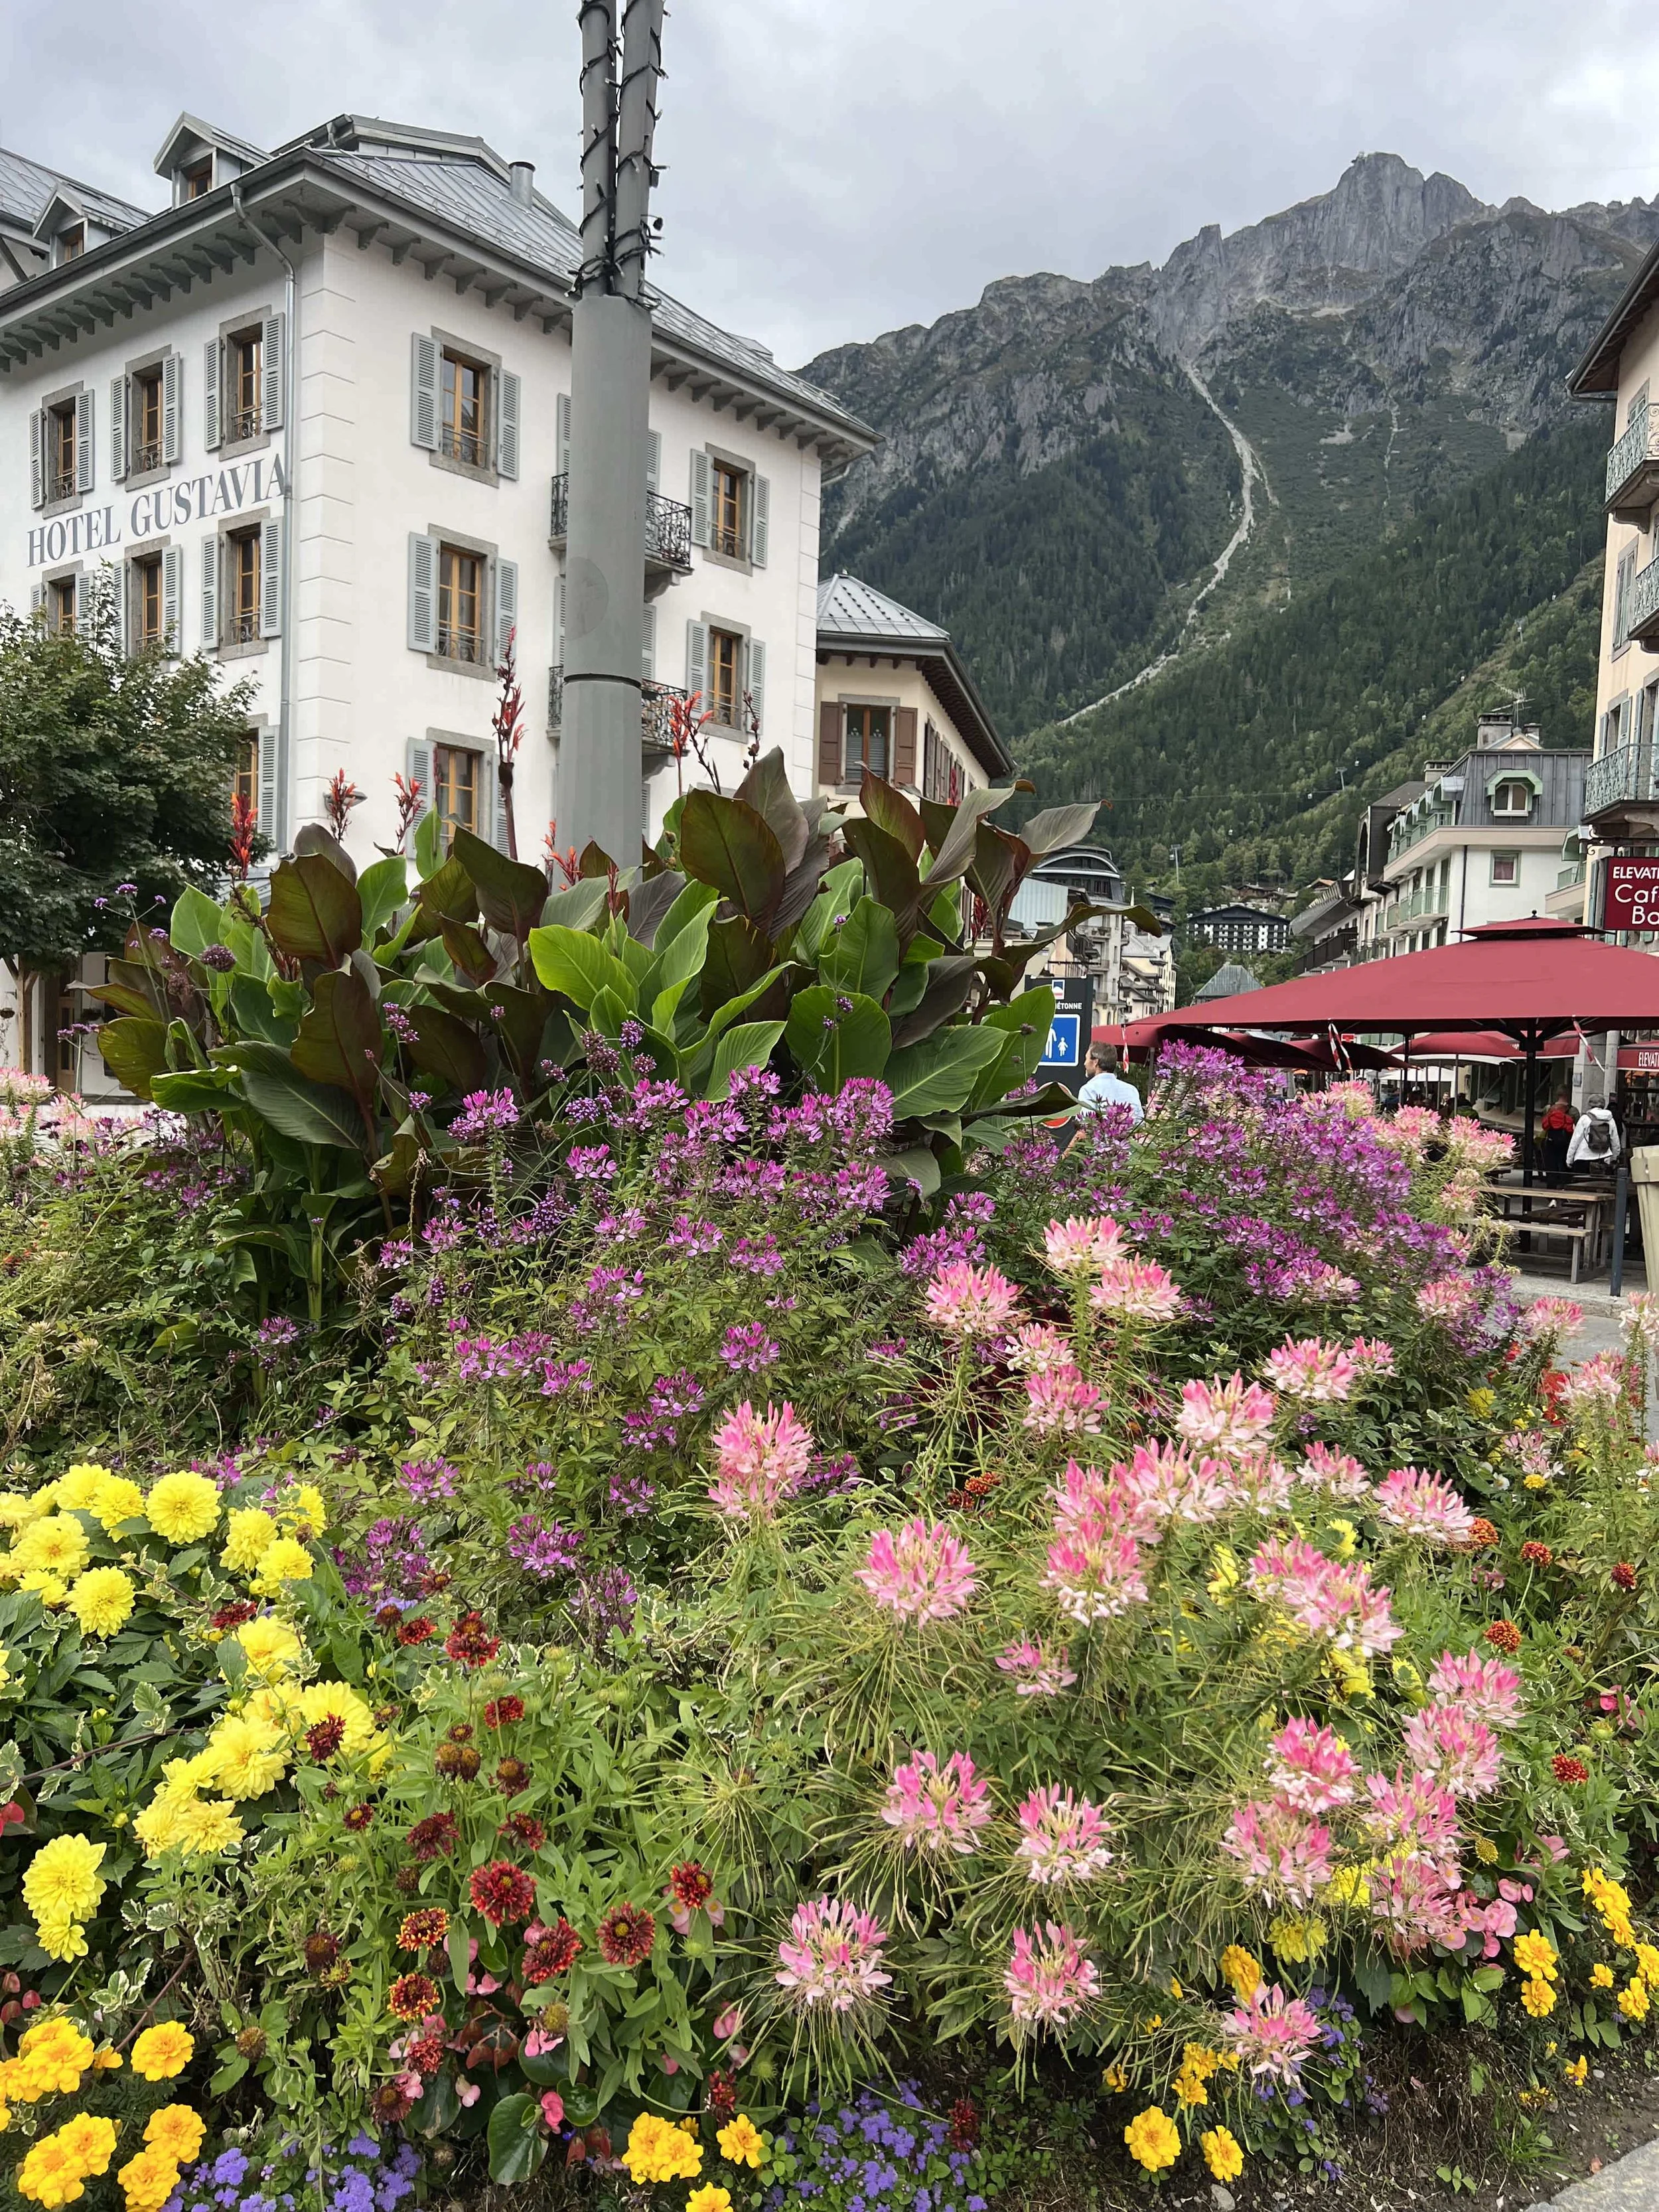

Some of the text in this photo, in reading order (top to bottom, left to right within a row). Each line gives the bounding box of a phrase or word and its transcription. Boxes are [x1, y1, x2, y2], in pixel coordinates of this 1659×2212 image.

[27, 453, 285, 567] HOTEL GUSTAVIA
[1615, 883, 1659, 903] Caf
